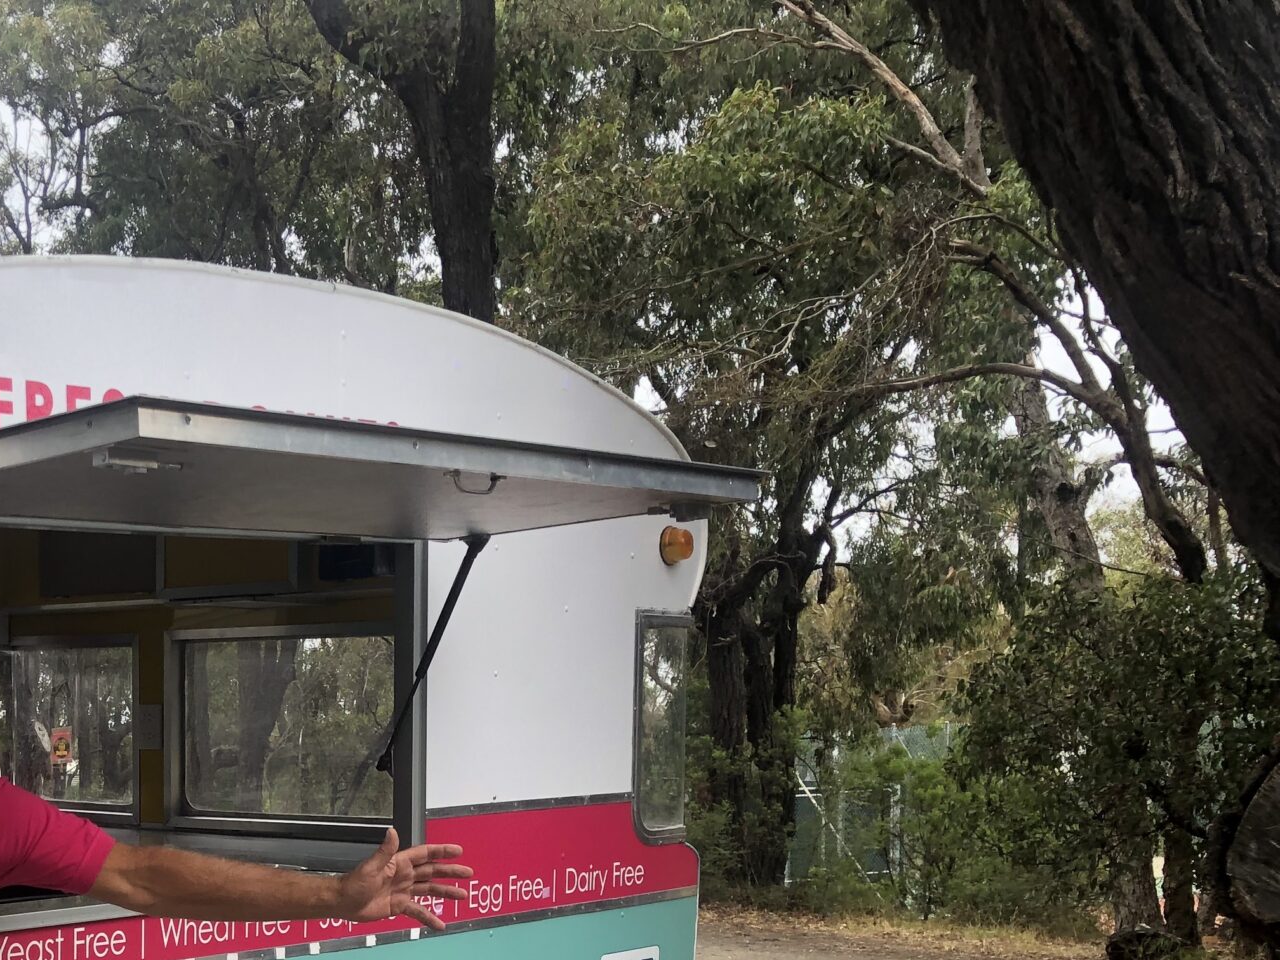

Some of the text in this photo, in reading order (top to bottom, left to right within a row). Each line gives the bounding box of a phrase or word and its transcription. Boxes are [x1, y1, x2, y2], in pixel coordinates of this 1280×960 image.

[73, 927, 127, 960] Free
[469, 880, 503, 914] Egg
[508, 875, 544, 902] Free
[565, 864, 609, 895] Dairy
[612, 862, 645, 888] Free
